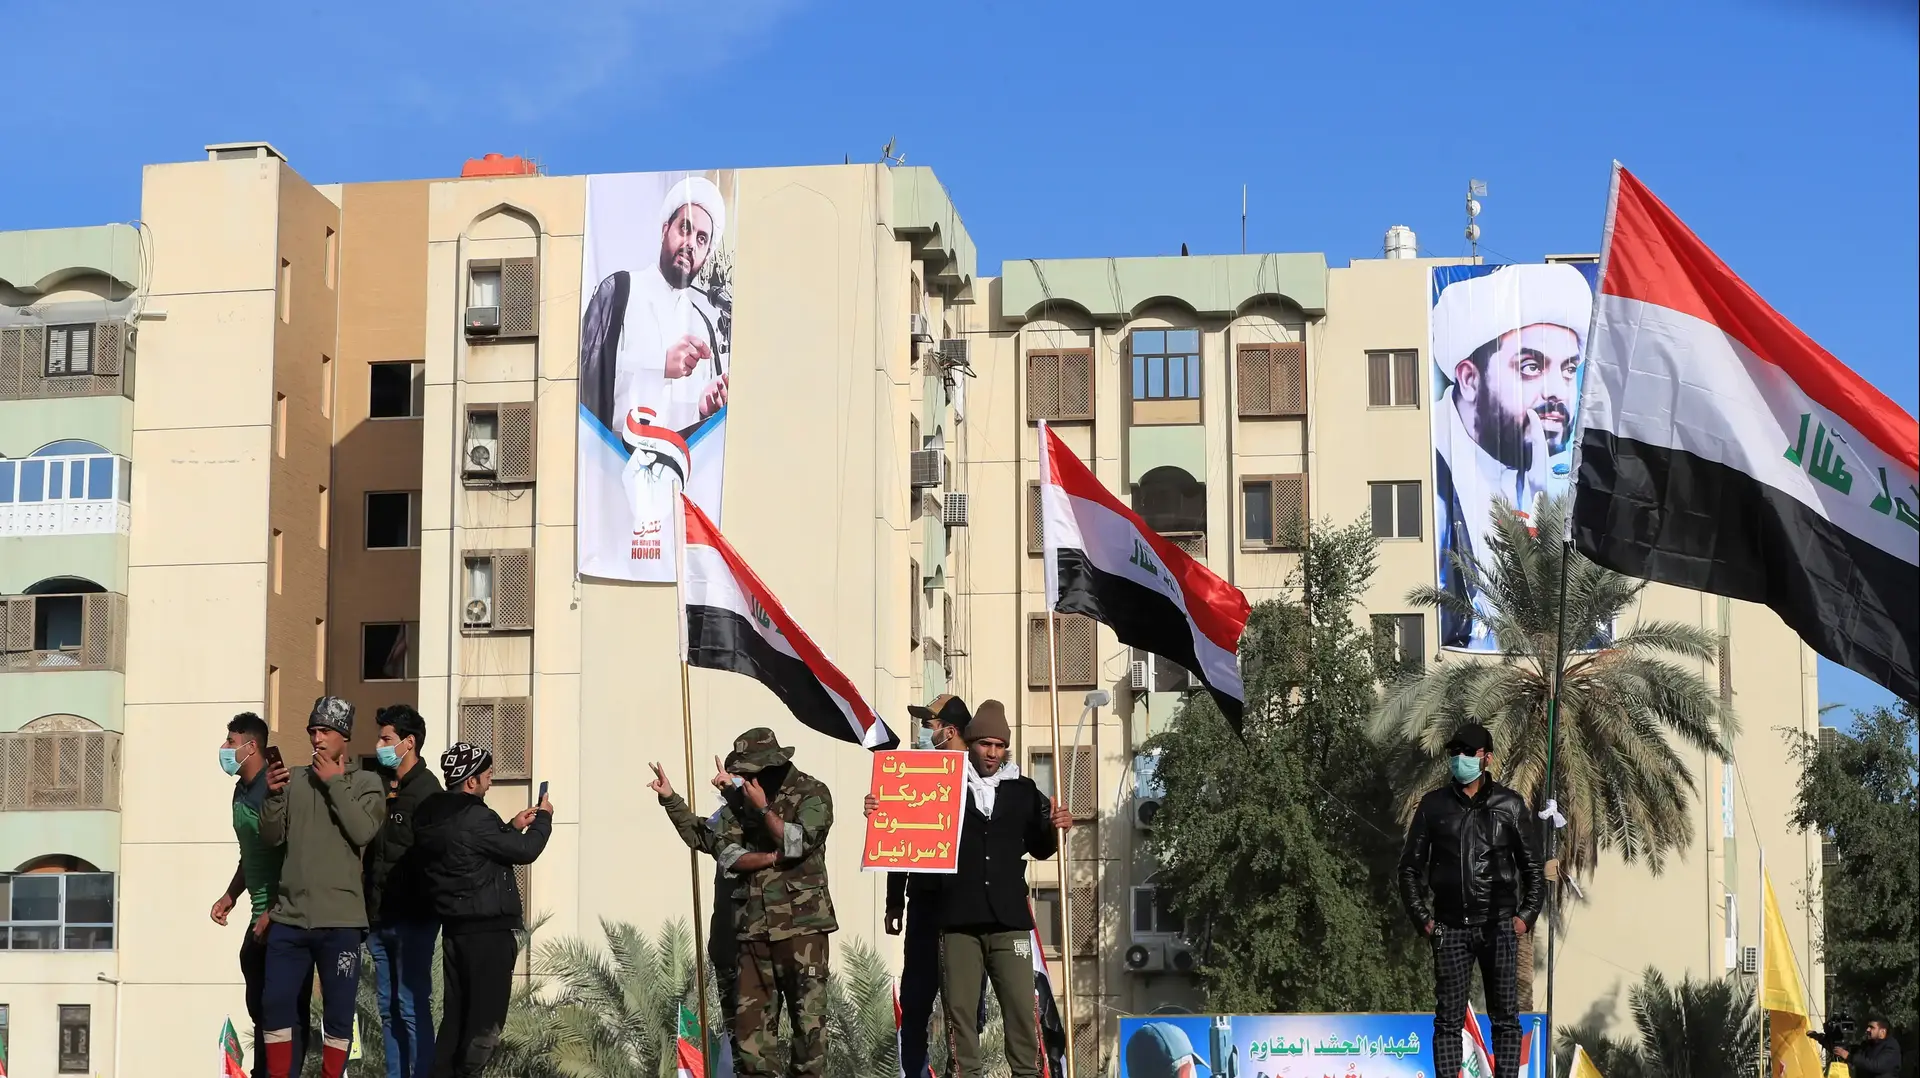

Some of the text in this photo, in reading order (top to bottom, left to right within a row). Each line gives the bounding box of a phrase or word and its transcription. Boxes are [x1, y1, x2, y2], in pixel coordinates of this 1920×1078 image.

[631, 539, 639, 547] WE
[652, 539, 661, 547] THE
[631, 547, 661, 560] HONOR
[881, 755, 956, 778] الموت
[879, 782, 952, 807] لأمريكا
[873, 811, 952, 834] الموت
[868, 839, 952, 863] لاسرائيل
[1249, 1035, 1310, 1061] المقاوم
[1314, 1033, 1368, 1057] الحشد
